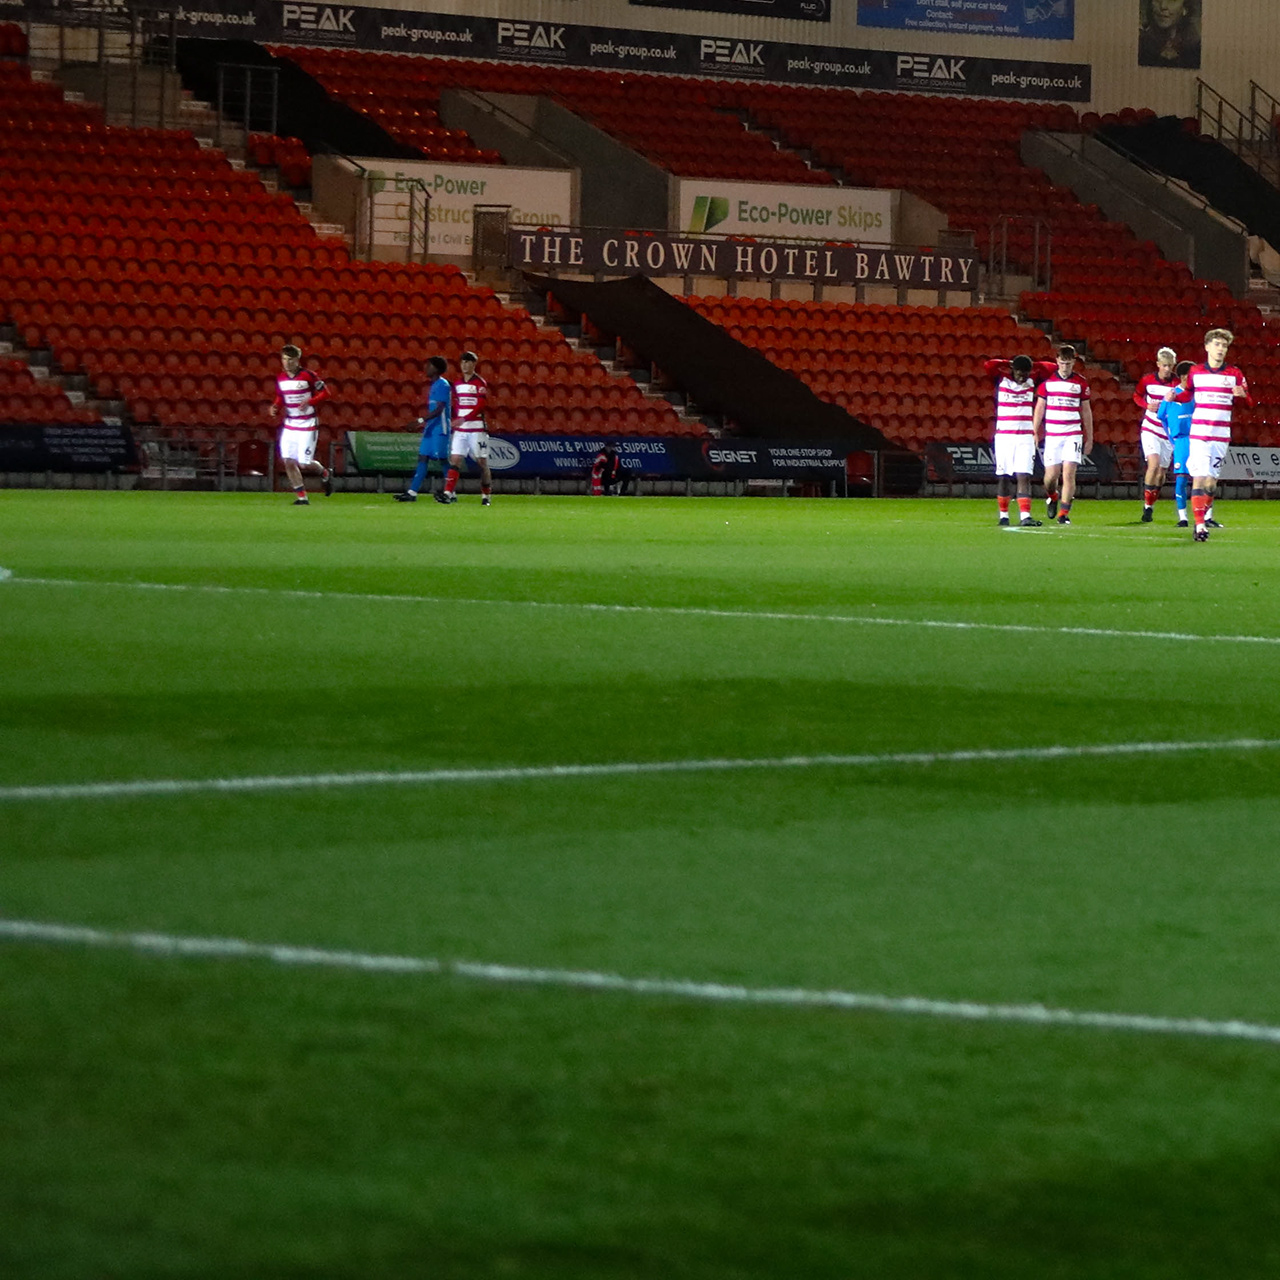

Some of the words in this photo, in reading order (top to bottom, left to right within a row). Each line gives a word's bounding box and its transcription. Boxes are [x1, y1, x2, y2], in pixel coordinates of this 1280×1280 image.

[281, 4, 356, 33] PEAK
[380, 23, 474, 43] peak-group.co.uk
[496, 21, 567, 50] PEAK
[589, 39, 678, 60] peak-group.co.uk
[699, 38, 766, 66] PEAK
[786, 56, 872, 77] peak-group.co.uk
[896, 54, 967, 81] PEAK
[991, 71, 1083, 91] peak-group.co.uk
[394, 171, 488, 196] Eco-Power
[737, 199, 833, 227] Eco-Power
[836, 204, 883, 232] Skips
[520, 234, 585, 265] THE
[602, 238, 719, 272] CROWN
[734, 245, 838, 278] HOTEL
[855, 252, 974, 285] BAWTRY
[304, 446, 312, 456] 6
[519, 440, 564, 452] BUILDING
[565, 441, 572, 452] &
[623, 442, 666, 454] SUPPLIES
[709, 450, 757, 463] SIGNET
[768, 448, 787, 457] YOUR
[816, 449, 833, 457] SHOP
[1222, 449, 1261, 466] ime
[773, 458, 787, 467] FOR
[787, 458, 823, 467] INDUSTRIAL
